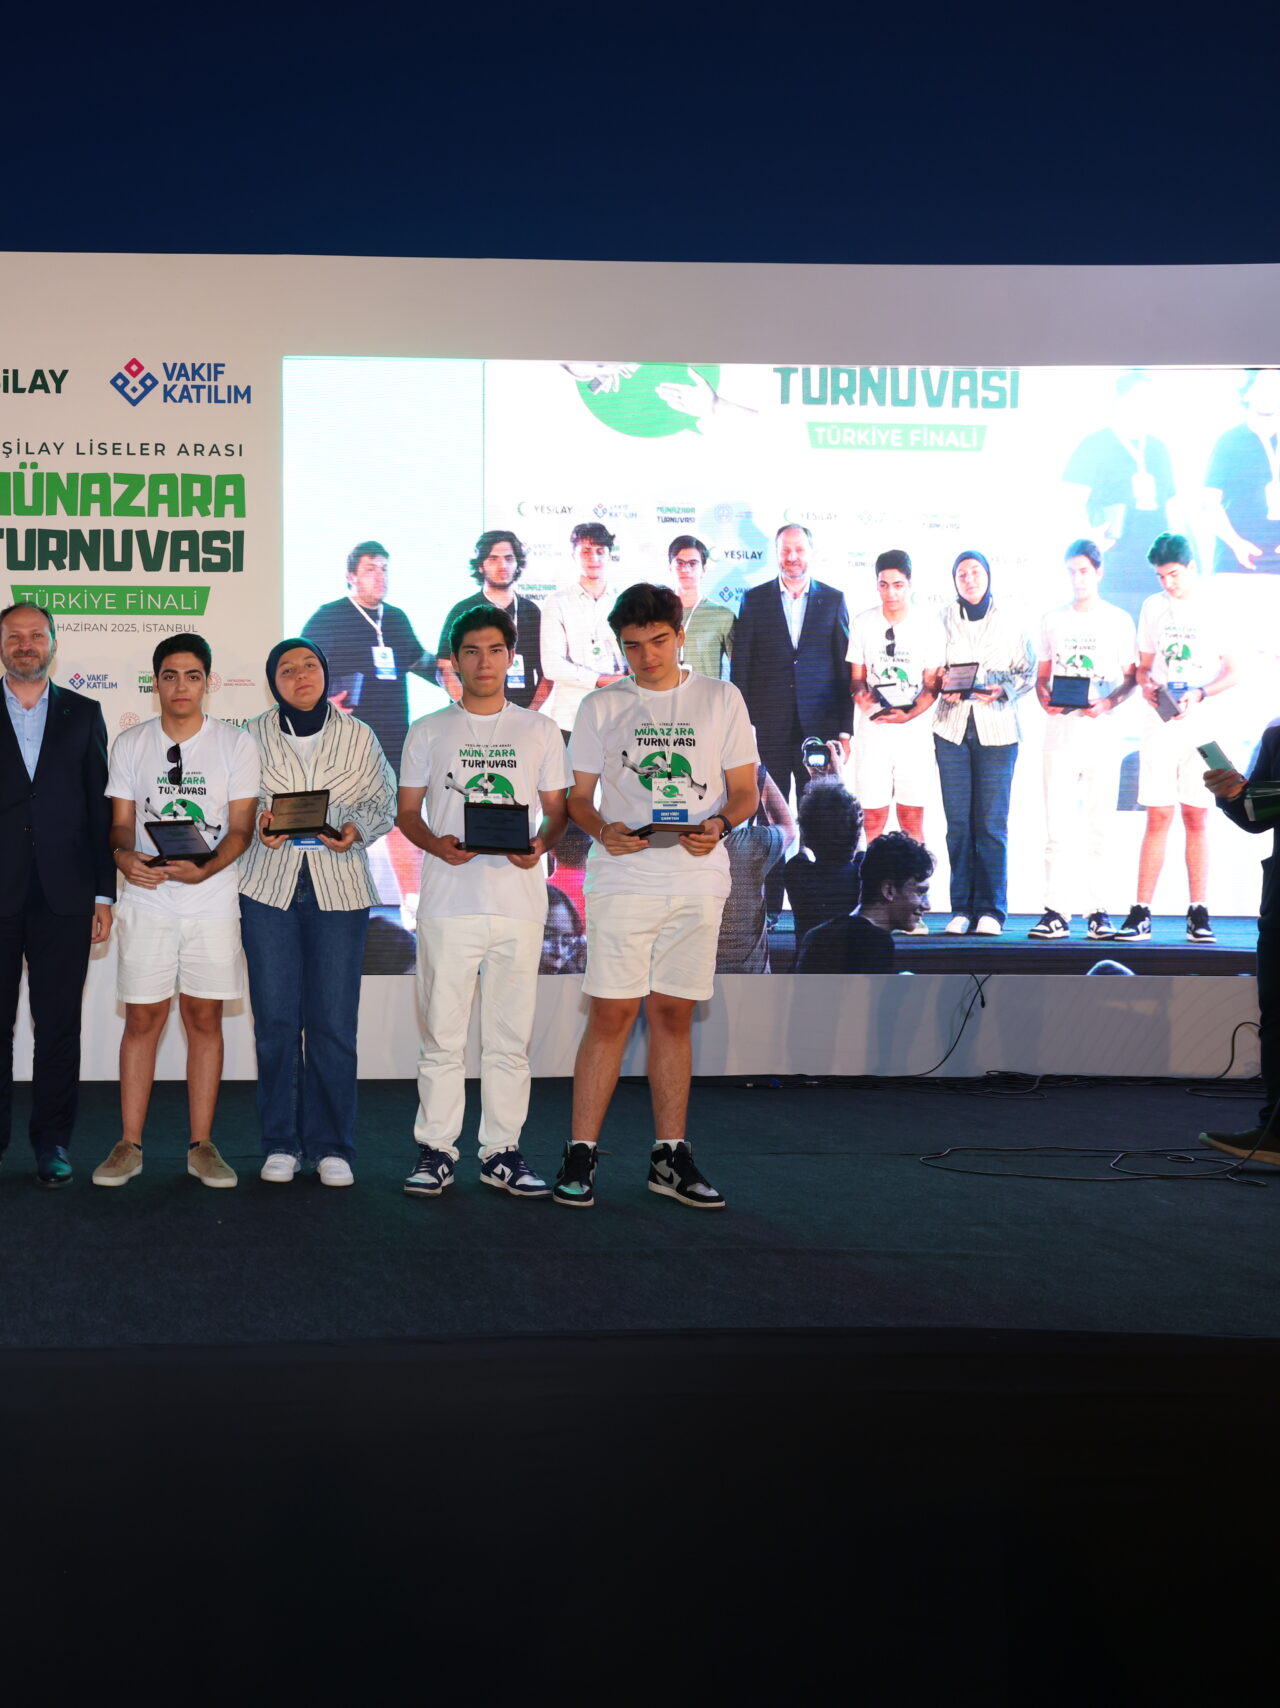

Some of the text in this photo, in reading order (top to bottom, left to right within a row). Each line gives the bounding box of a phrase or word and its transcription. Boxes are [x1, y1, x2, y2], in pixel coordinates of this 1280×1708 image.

[163, 362, 226, 382] VAKIF
[162, 384, 252, 405] KATILIM
[773, 366, 1020, 409] TURNUVASI
[814, 423, 979, 449] TÜRKİYE FİNALİ
[76, 438, 166, 457] LİSELER
[176, 442, 244, 458] ARASI
[22, 590, 198, 611] TÜRKİYE FİNALİ
[56, 621, 198, 634] HAZİRAN 2025, İSTANBUL
[86, 681, 118, 689] KATILIM
